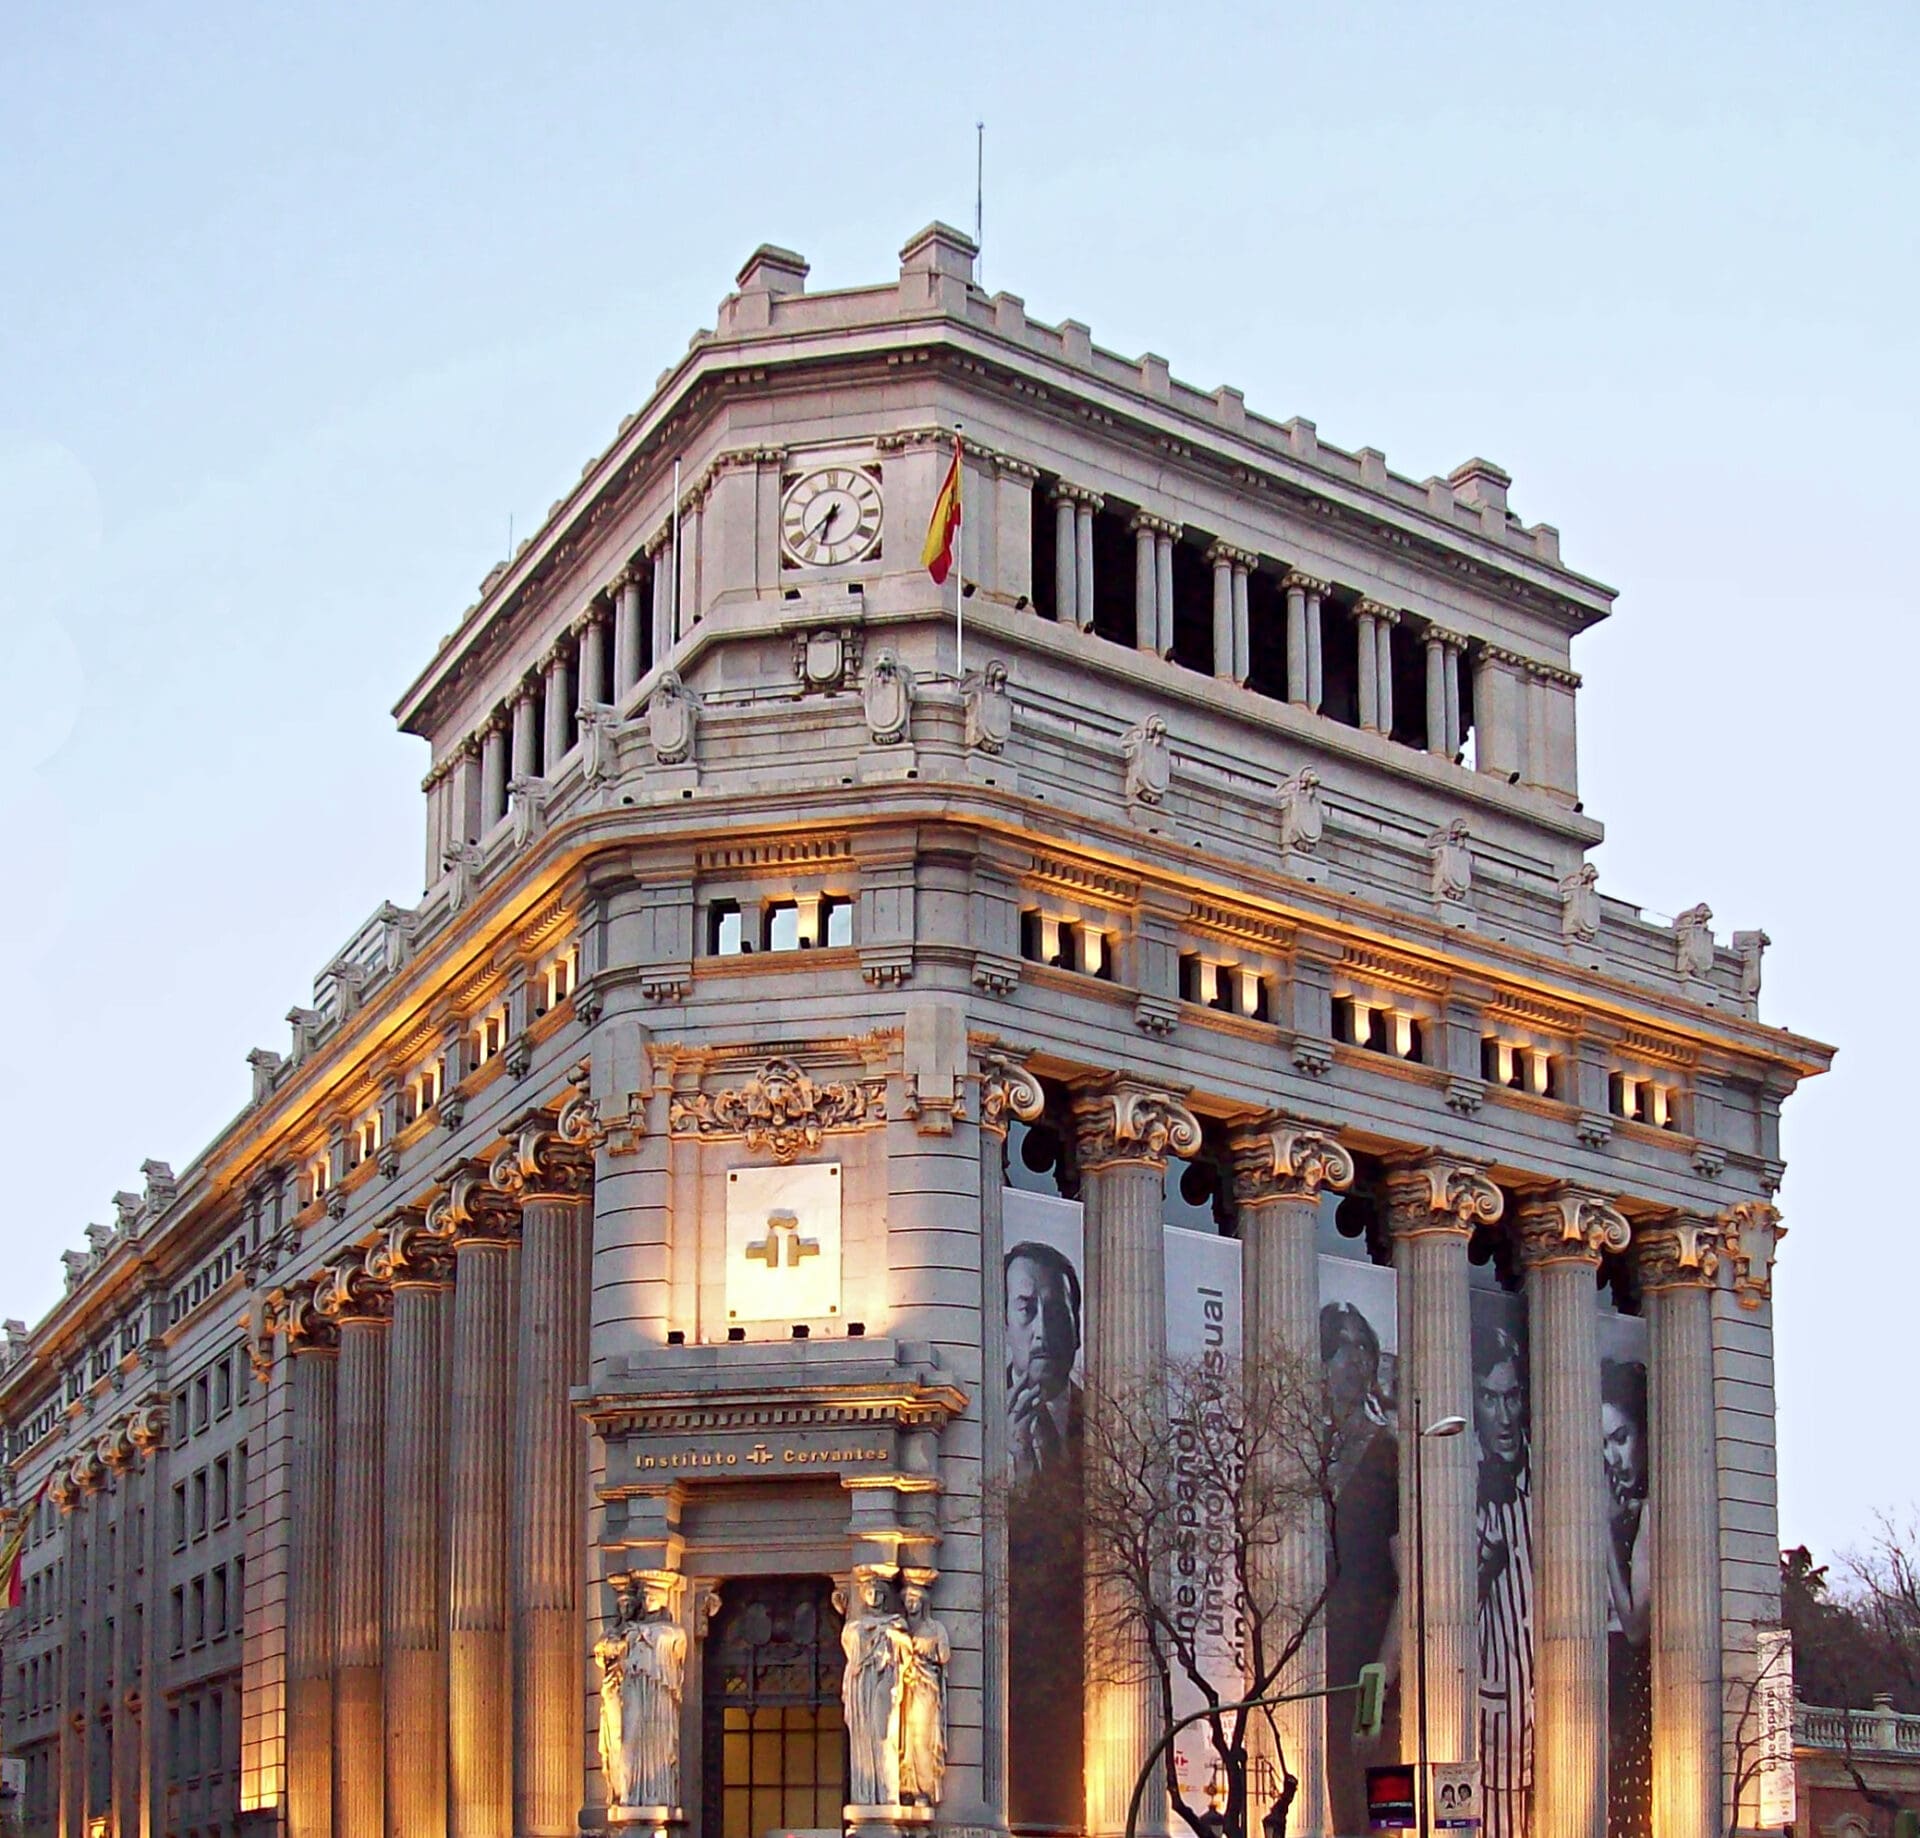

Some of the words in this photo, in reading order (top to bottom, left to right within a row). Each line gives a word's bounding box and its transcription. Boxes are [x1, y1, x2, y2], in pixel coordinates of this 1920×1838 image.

[1197, 1288, 1223, 1401] visual
[635, 1452, 738, 1469] Instituto
[783, 1448, 888, 1464] Cervantes
[1204, 1566, 1224, 1637] una
